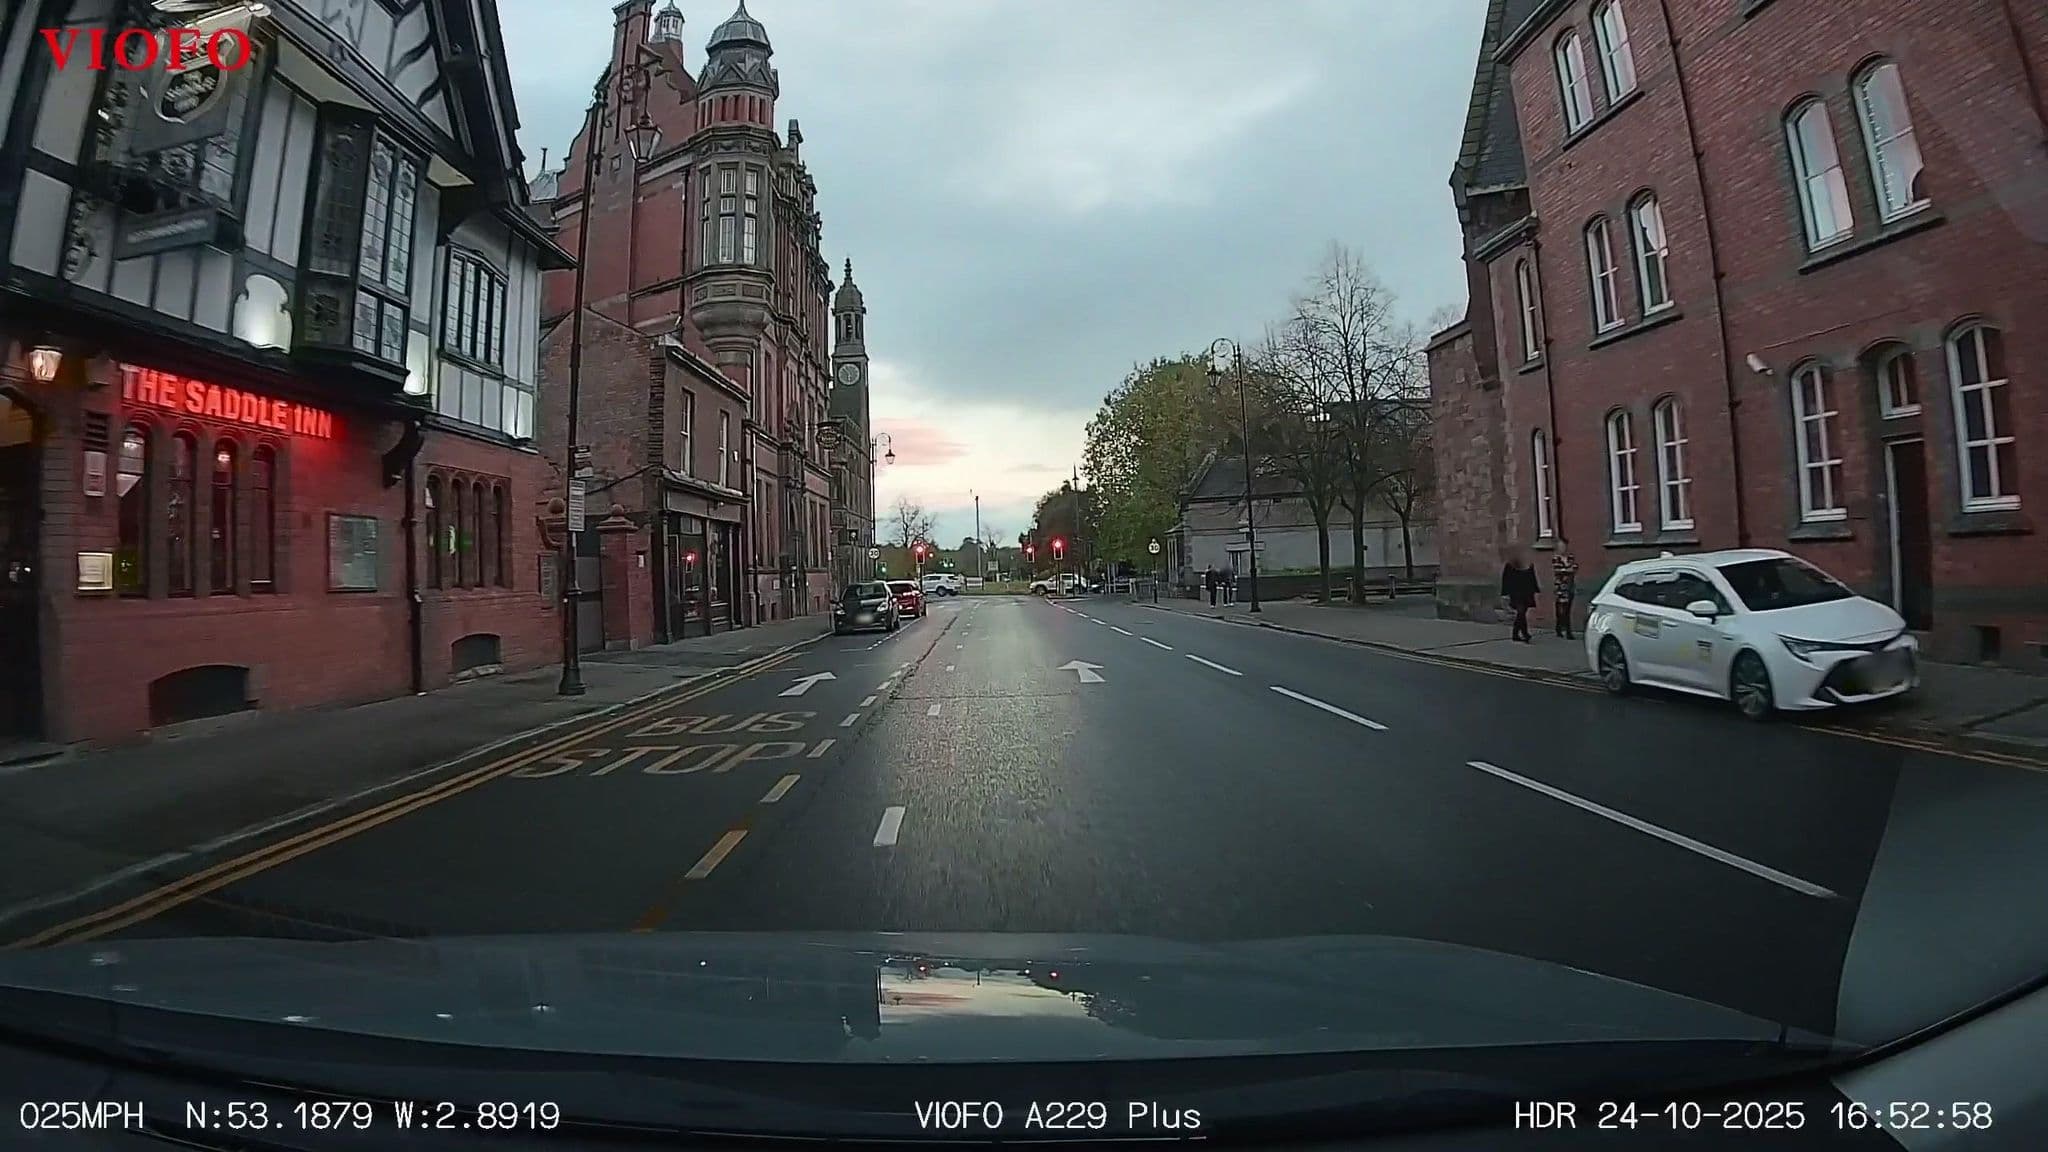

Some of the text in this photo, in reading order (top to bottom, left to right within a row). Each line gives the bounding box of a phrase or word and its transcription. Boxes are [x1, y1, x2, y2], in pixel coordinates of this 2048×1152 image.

[119, 363, 332, 438] THE SADDLE INN
[626, 712, 817, 737] BUS
[510, 742, 807, 778] STOP
